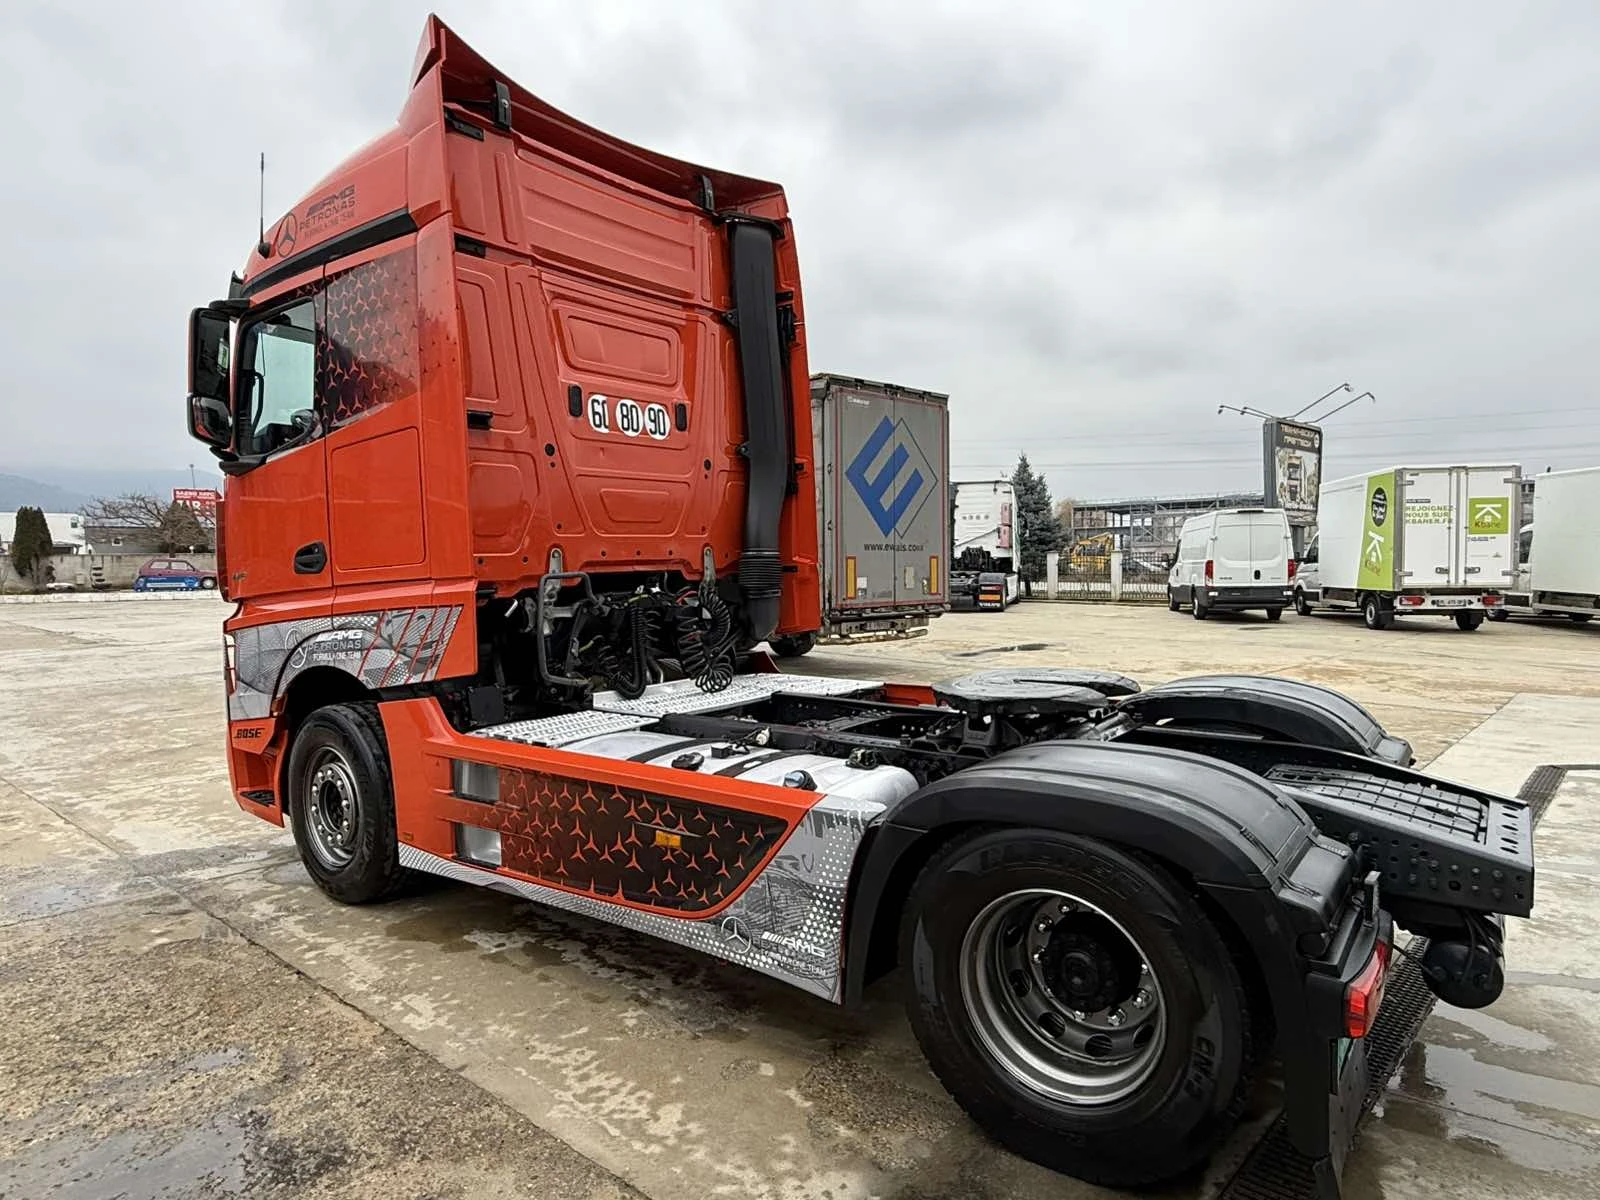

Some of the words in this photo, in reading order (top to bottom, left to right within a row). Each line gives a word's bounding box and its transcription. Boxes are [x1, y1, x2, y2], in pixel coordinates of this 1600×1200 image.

[299, 197, 355, 231] PETRONAS
[620, 402, 640, 433] 80
[647, 406, 666, 436] 90
[308, 640, 362, 652] PETRONAS
[236, 728, 264, 738] BOSE
